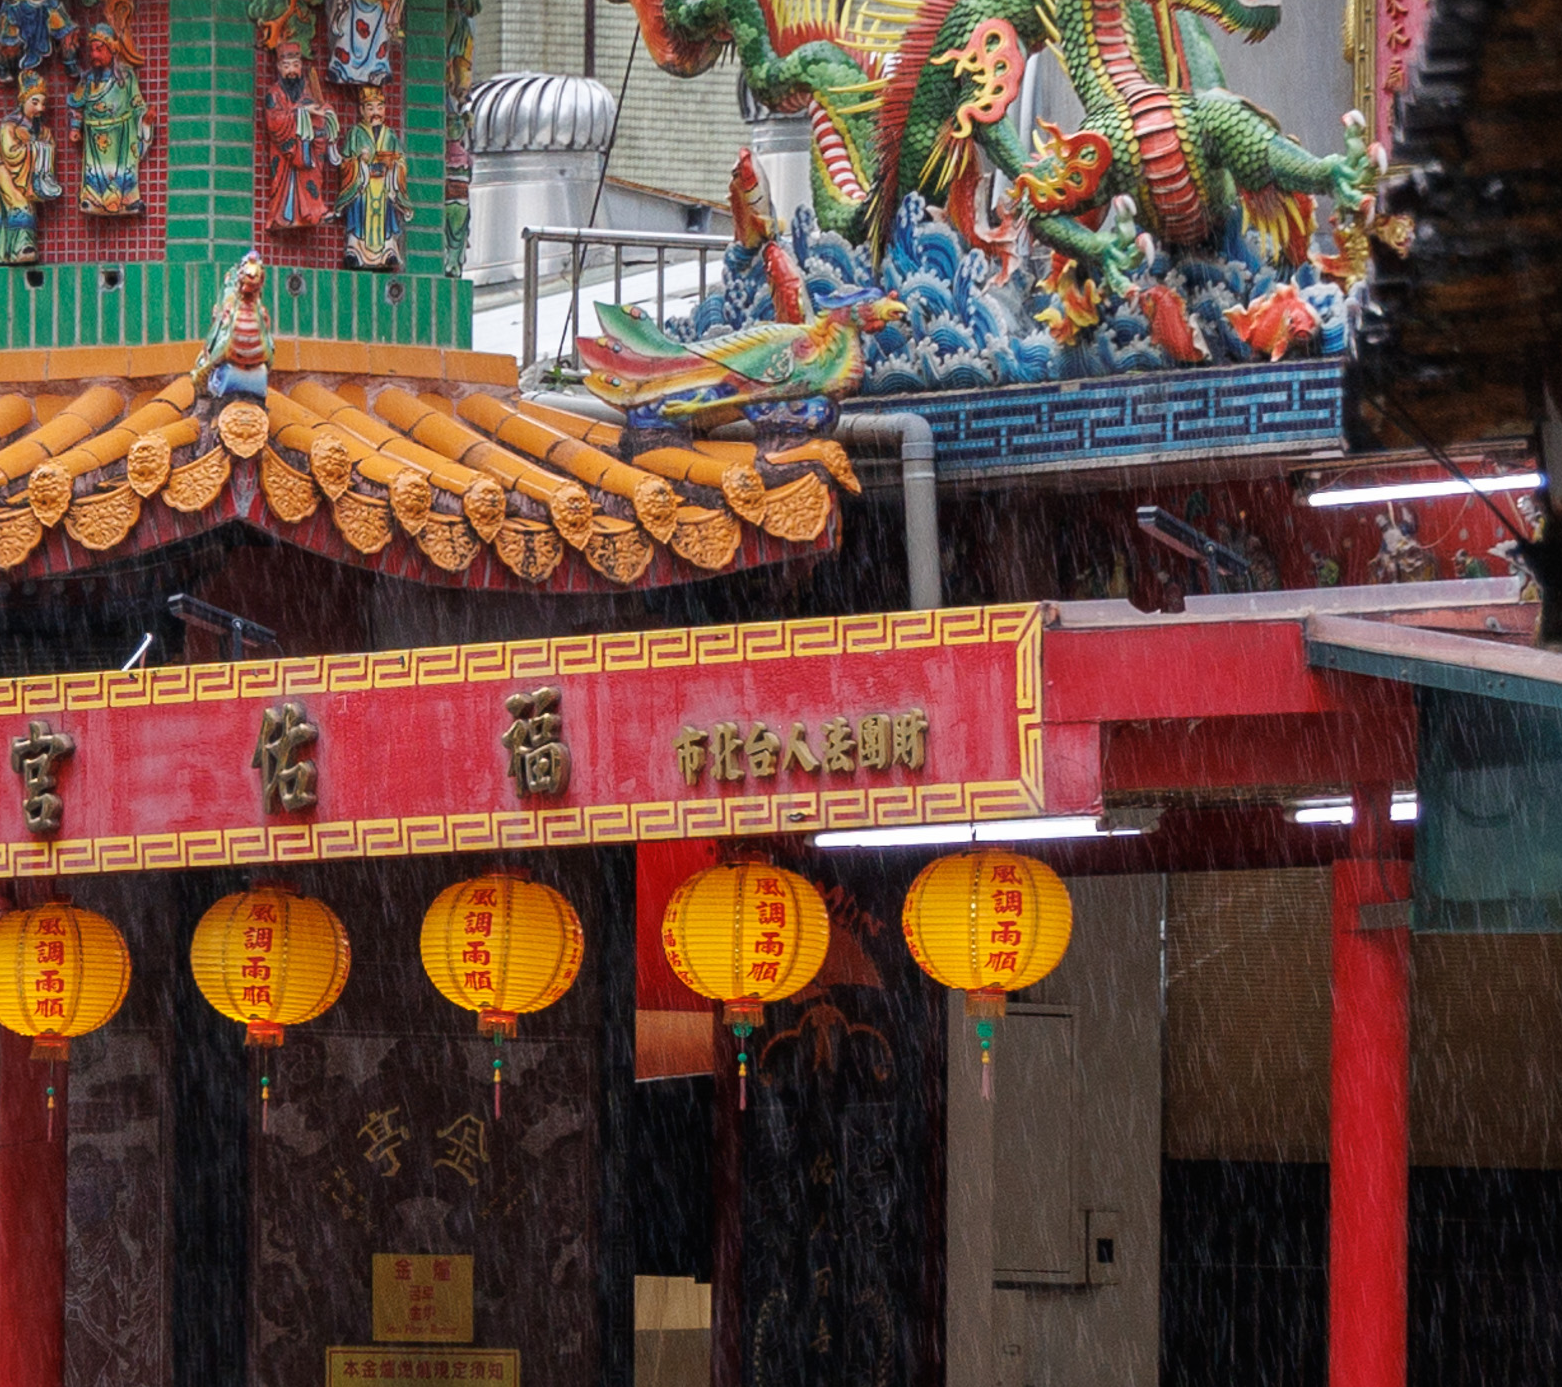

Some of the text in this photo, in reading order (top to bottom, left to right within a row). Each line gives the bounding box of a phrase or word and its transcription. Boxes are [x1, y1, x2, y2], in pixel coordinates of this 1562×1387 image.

[12, 686, 928, 834] 財團法人台北市 福佑宮
[33, 916, 67, 1019] 風調雨順
[241, 903, 278, 1008] 風調雨順
[462, 888, 498, 993] 風調雨順
[746, 878, 786, 984] 風調雨順
[984, 864, 1024, 974] 風調雨順
